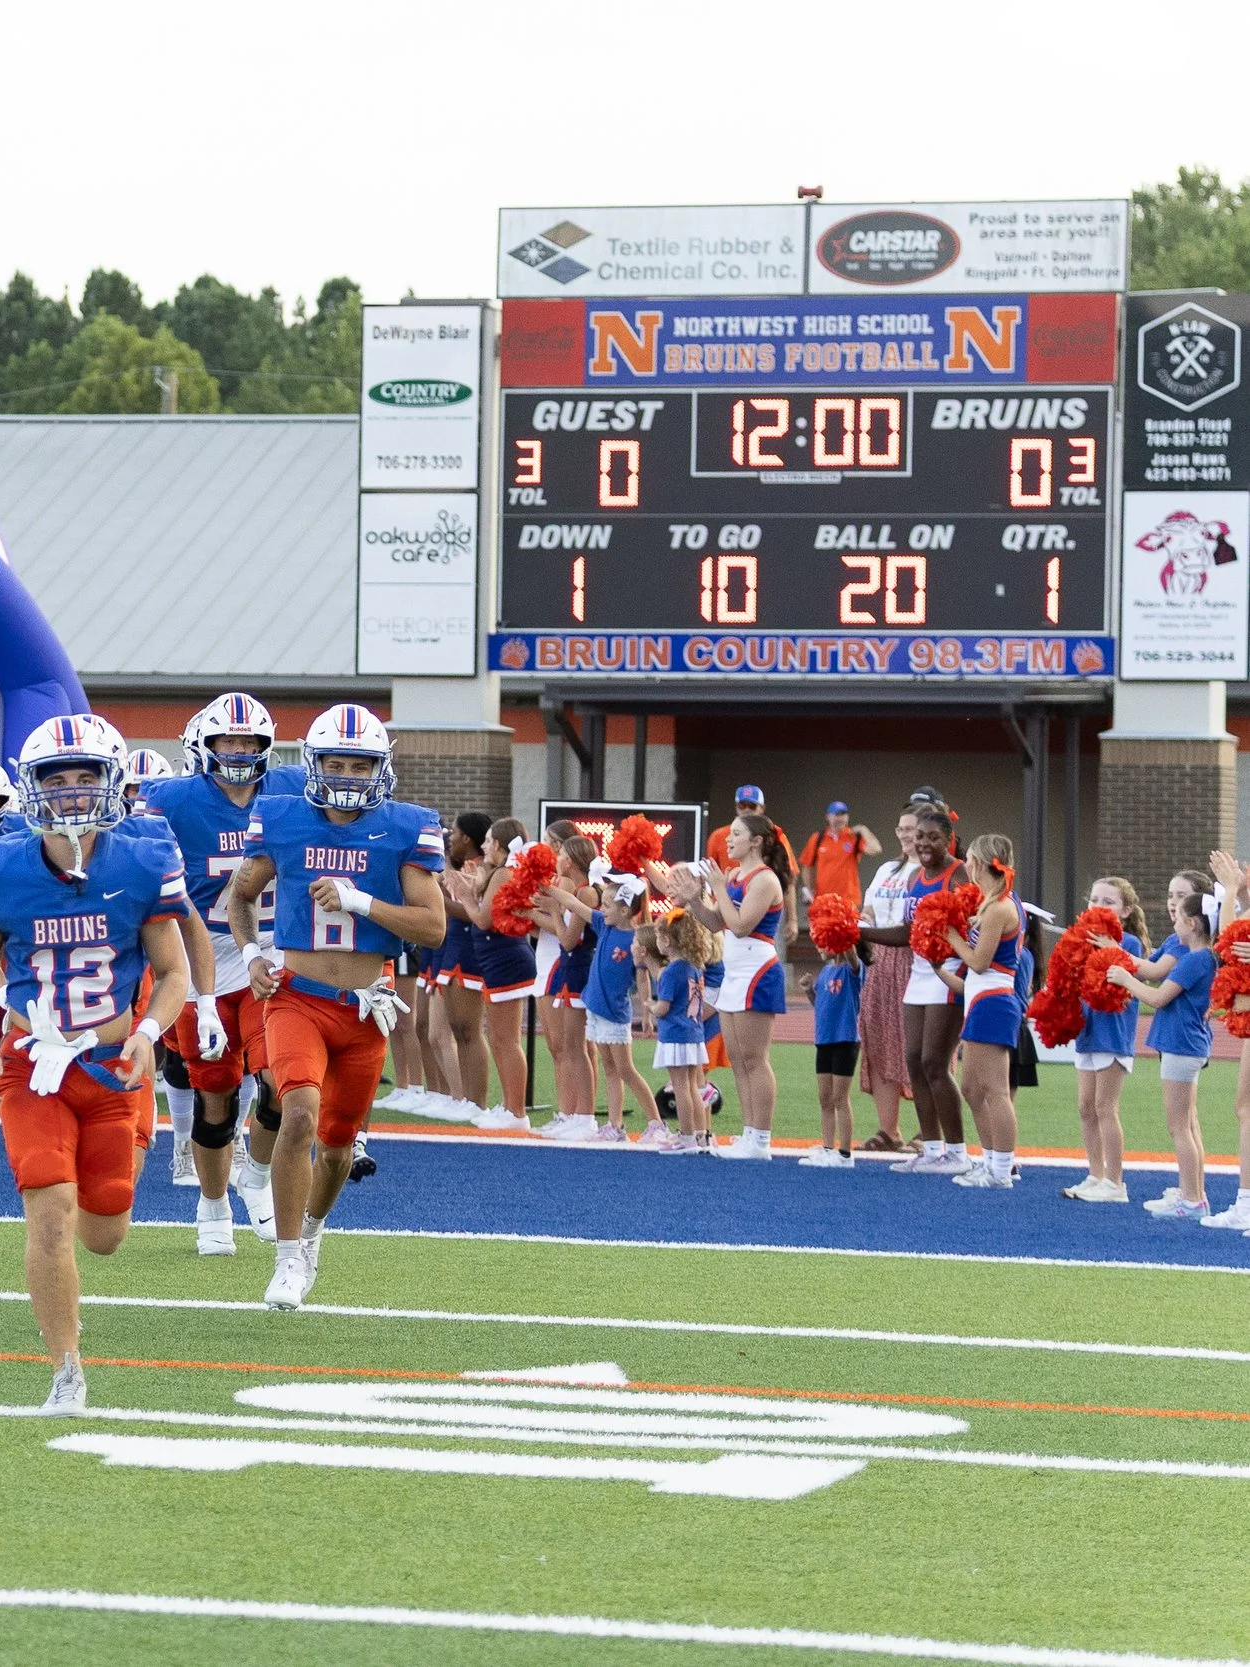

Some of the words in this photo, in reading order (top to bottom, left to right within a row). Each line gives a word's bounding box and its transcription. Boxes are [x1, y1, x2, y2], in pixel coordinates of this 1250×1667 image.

[969, 212, 1017, 224] Proud
[1024, 213, 1040, 224] to
[1049, 213, 1094, 223] serve
[1100, 213, 1120, 223] an
[607, 238, 681, 256] Textile
[688, 237, 771, 256] Rubber
[780, 237, 795, 255] &
[850, 230, 942, 253] CARSTAR
[979, 229, 1017, 239] area
[1024, 228, 1060, 238] near
[598, 262, 701, 280] Chemical
[711, 262, 748, 280] Co.
[757, 261, 797, 279] Inc.
[372, 325, 434, 343] DeWayne
[439, 325, 470, 340] Blair
[673, 316, 797, 337] NORTHWEST
[803, 315, 852, 336] HIGH
[857, 314, 934, 335] SCHOOL
[944, 305, 1022, 373] N
[589, 310, 663, 376] N
[664, 343, 776, 373] BRUINS
[784, 341, 940, 372] FOOTBALL
[380, 383, 460, 399] COUNTRY
[532, 400, 664, 431] GUEST
[931, 398, 1089, 430] BRUINS
[731, 398, 901, 467] 12:00
[514, 439, 542, 484] 3
[599, 439, 640, 507] 0
[1010, 438, 1052, 507] 0
[1067, 437, 1096, 483] 3
[508, 488, 547, 506] TOL
[1059, 487, 1101, 506] TOL
[365, 526, 472, 545] oakwood
[518, 524, 613, 549] DOWN
[668, 524, 709, 549] TO
[717, 524, 762, 549] GO
[814, 524, 897, 550] BALL
[908, 524, 955, 550] ON
[1001, 524, 1076, 551] QTR.
[572, 556, 586, 623] 1
[700, 555, 758, 624] 10
[840, 555, 926, 624] 20
[1046, 556, 1060, 624] 1
[364, 616, 471, 635] CHEROKEE
[536, 637, 671, 670] BRUIN
[683, 637, 898, 673] COUNTRY
[908, 637, 1066, 673] 98.3FM
[304, 847, 368, 872] BRUINS
[33, 914, 108, 945] BRUINS
[29, 944, 118, 1028] 12
